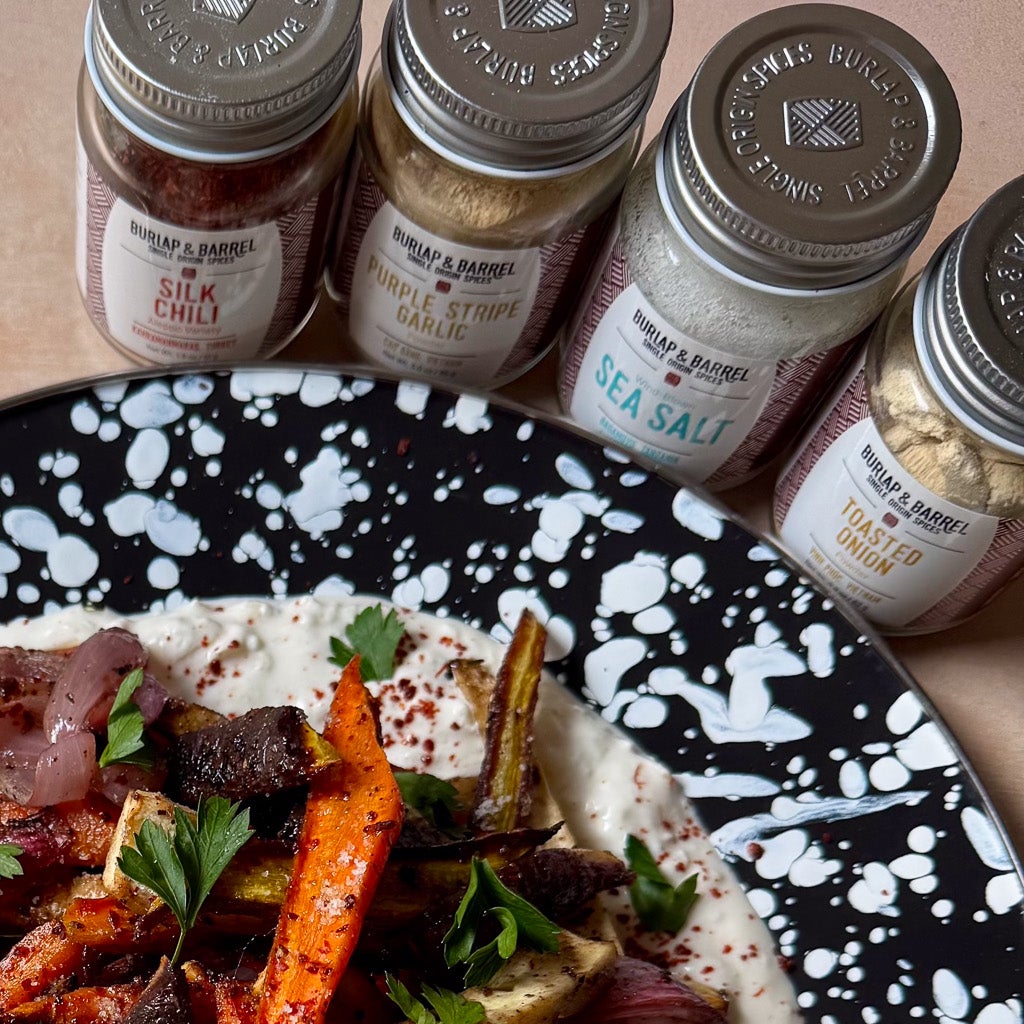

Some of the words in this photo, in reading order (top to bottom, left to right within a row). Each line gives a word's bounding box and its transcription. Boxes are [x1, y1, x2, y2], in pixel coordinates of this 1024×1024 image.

[140, 0, 192, 54] BARR
[218, 16, 307, 68] BURLAP
[193, 44, 210, 65] &
[452, 27, 536, 86] BURLAP
[550, 33, 620, 86] SPICES
[742, 43, 814, 90] SPICES
[828, 44, 910, 107] BURLAP
[729, 88, 761, 157] ORIGIN
[748, 155, 824, 204] SINGLE
[841, 136, 915, 203] BARREL
[130, 220, 181, 252] BURLAP
[183, 243, 195, 256] &
[198, 239, 257, 258] BARREL
[176, 255, 204, 265] ORIGIN
[207, 255, 235, 266] SPICES
[392, 225, 442, 264] BURLAP
[442, 256, 454, 270] &
[457, 258, 516, 280] BARREL
[159, 277, 217, 304] SILK
[368, 254, 437, 312] PURPLE
[446, 300, 521, 323] STRIPE
[406, 252, 433, 271] SINGLE
[434, 266, 462, 281] ORIGIN
[463, 274, 493, 285] SPICES
[154, 298, 220, 326] CHILI
[396, 304, 469, 342] GARLIC
[632, 308, 677, 354] BURLAP
[676, 349, 688, 364] &
[690, 354, 749, 383] BARREL
[642, 338, 666, 362] SINGLE
[667, 358, 694, 376] ORIGIN
[694, 371, 724, 386] SPICES
[595, 353, 641, 421] SEA
[647, 402, 735, 446] SALT
[860, 444, 902, 494] BURLAP
[899, 491, 911, 507] &
[910, 500, 970, 536] BARREL
[866, 474, 889, 500] SINGLE
[887, 498, 913, 520] ORIGIN
[912, 517, 944, 536] SPICES
[836, 525, 896, 578] ONION
[840, 495, 925, 567] TOASTED
